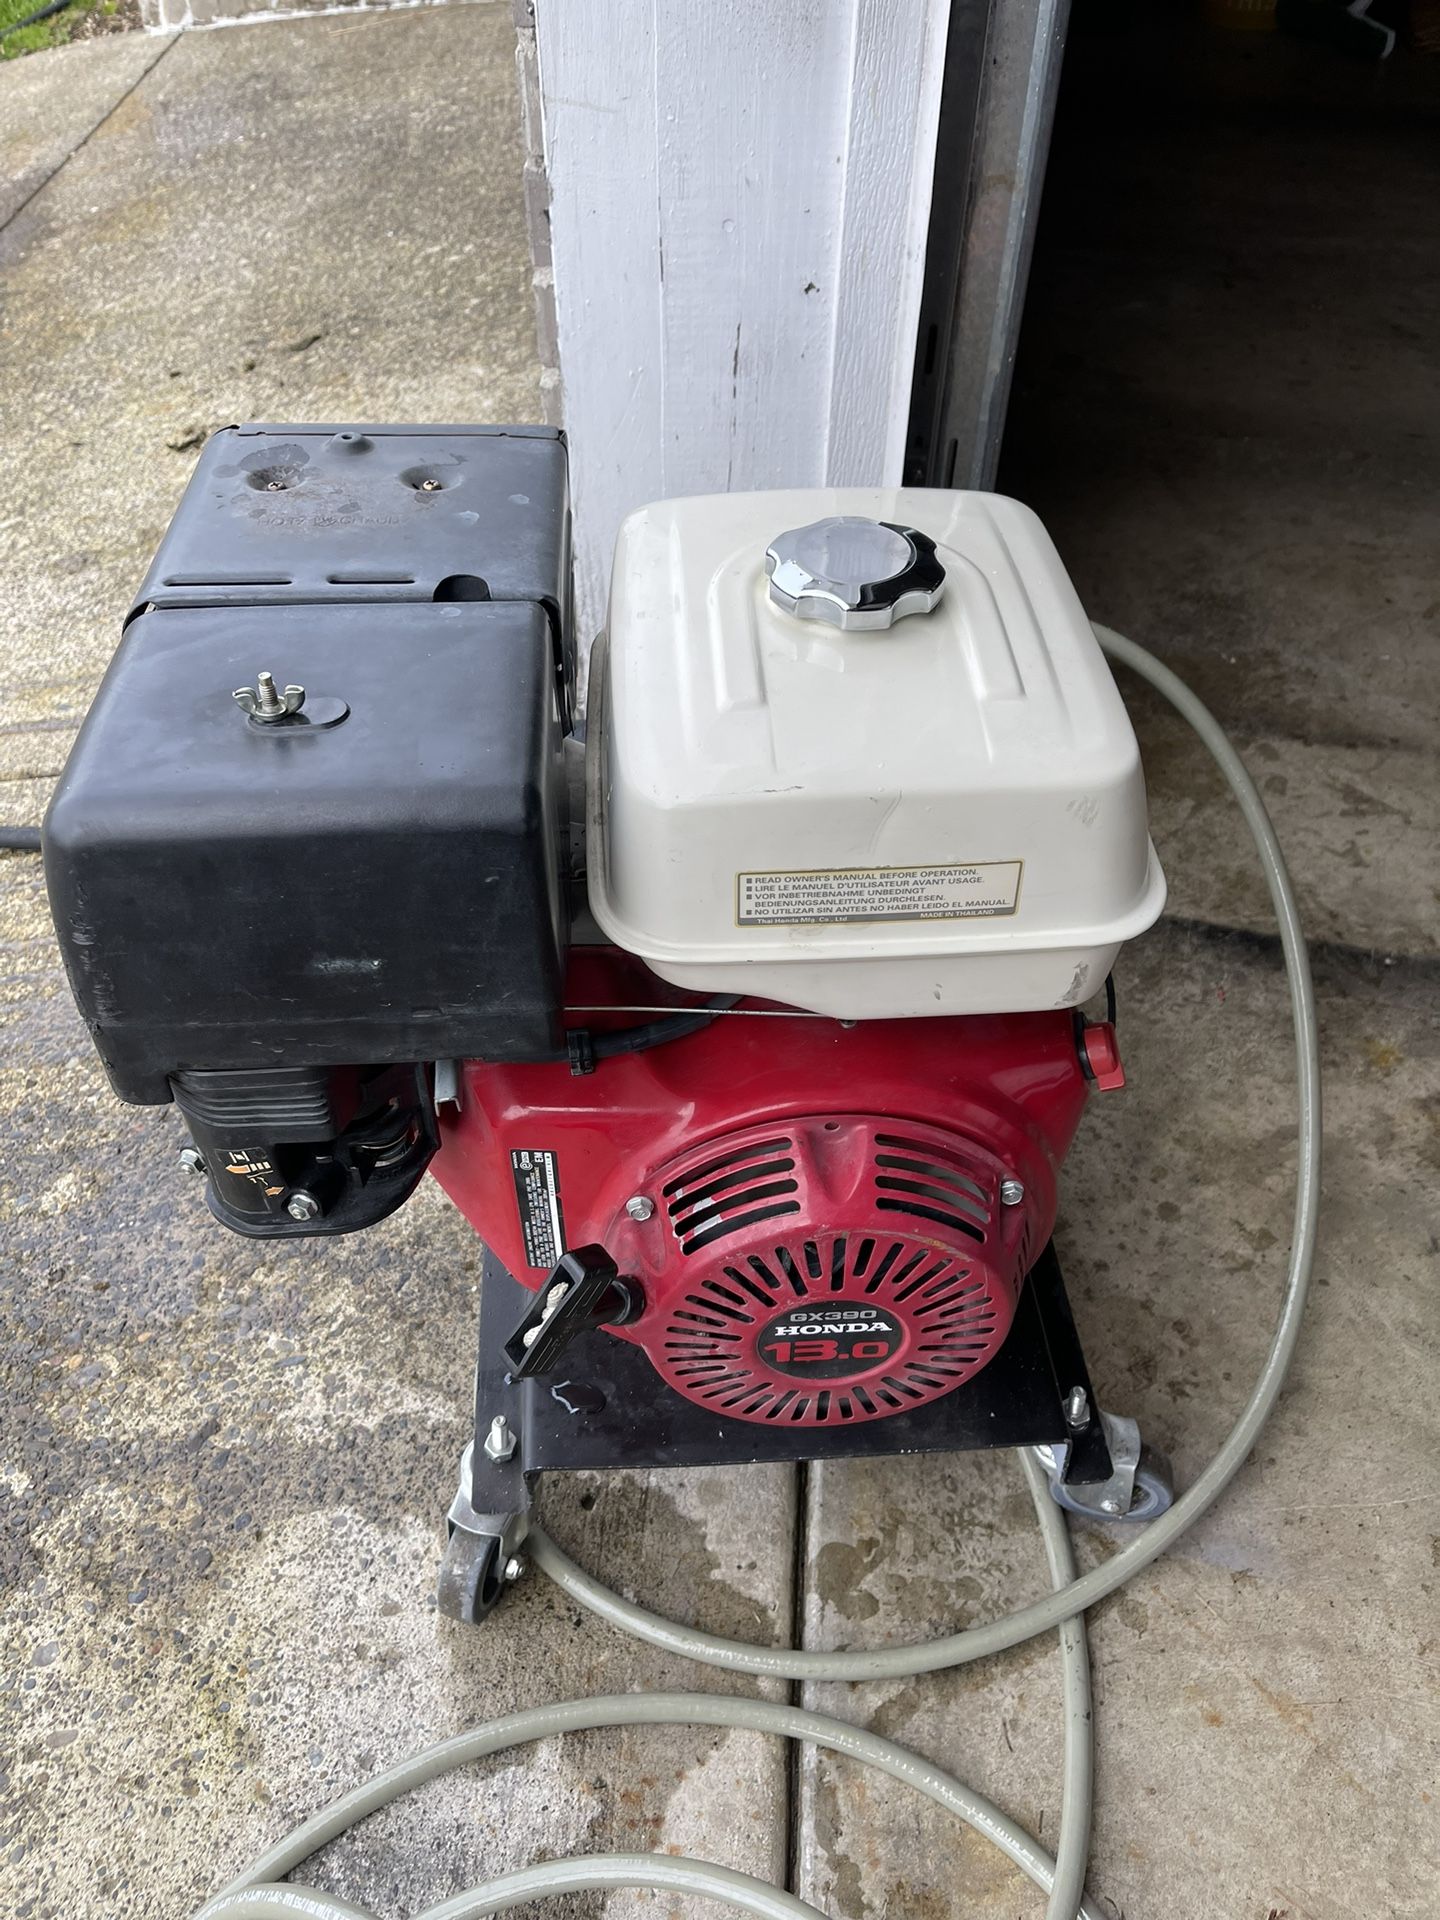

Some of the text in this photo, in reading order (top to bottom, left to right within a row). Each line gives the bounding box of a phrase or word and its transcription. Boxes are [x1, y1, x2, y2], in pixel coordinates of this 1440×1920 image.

[784, 875, 830, 883] OWNER'S
[833, 873, 877, 881] MANUAL
[880, 871, 918, 879] BEFORE
[920, 869, 978, 878] OPERATION.
[792, 882, 835, 890] MANUEL
[837, 880, 910, 889] D'UTILISATEUR
[912, 878, 945, 886] AVANT
[948, 877, 985, 885] USAGE.
[778, 890, 865, 899] INBETRIEBNAHME
[867, 888, 926, 896] UNBEDINGT
[754, 894, 946, 907] BEDIENUNGSANLEITUNG DURCHLESEN.
[772, 907, 814, 915] UTILIZAR
[835, 905, 868, 913] ANTES
[887, 903, 919, 911] HABER
[956, 909, 995, 917] THAILAND
[789, 1309, 878, 1322] GX390
[774, 1321, 893, 1336] HONDA
[763, 1339, 890, 1363] 13.0
